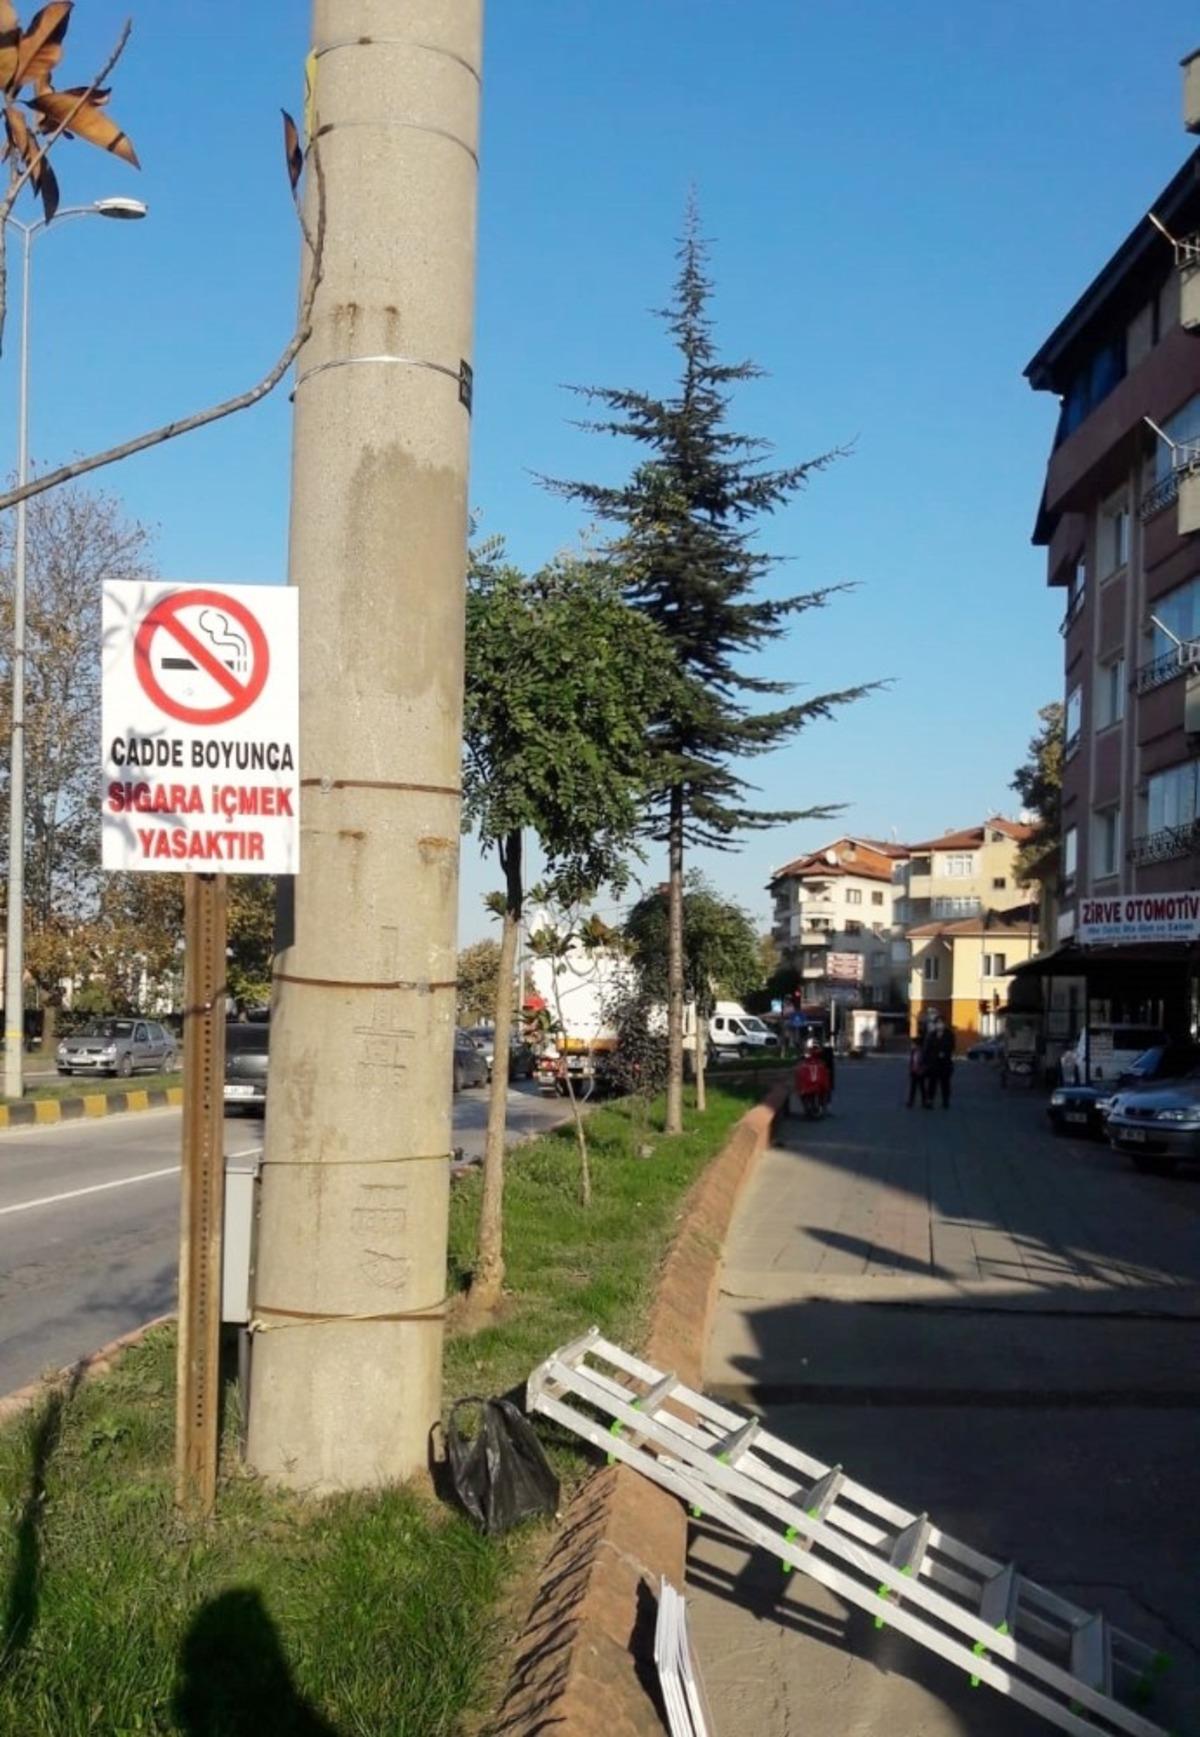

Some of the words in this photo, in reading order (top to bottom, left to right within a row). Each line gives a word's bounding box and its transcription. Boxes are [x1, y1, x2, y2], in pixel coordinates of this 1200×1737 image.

[111, 737, 183, 767] CADDE
[191, 740, 294, 771] BOYUNCA
[137, 828, 265, 860] YASAKTIR
